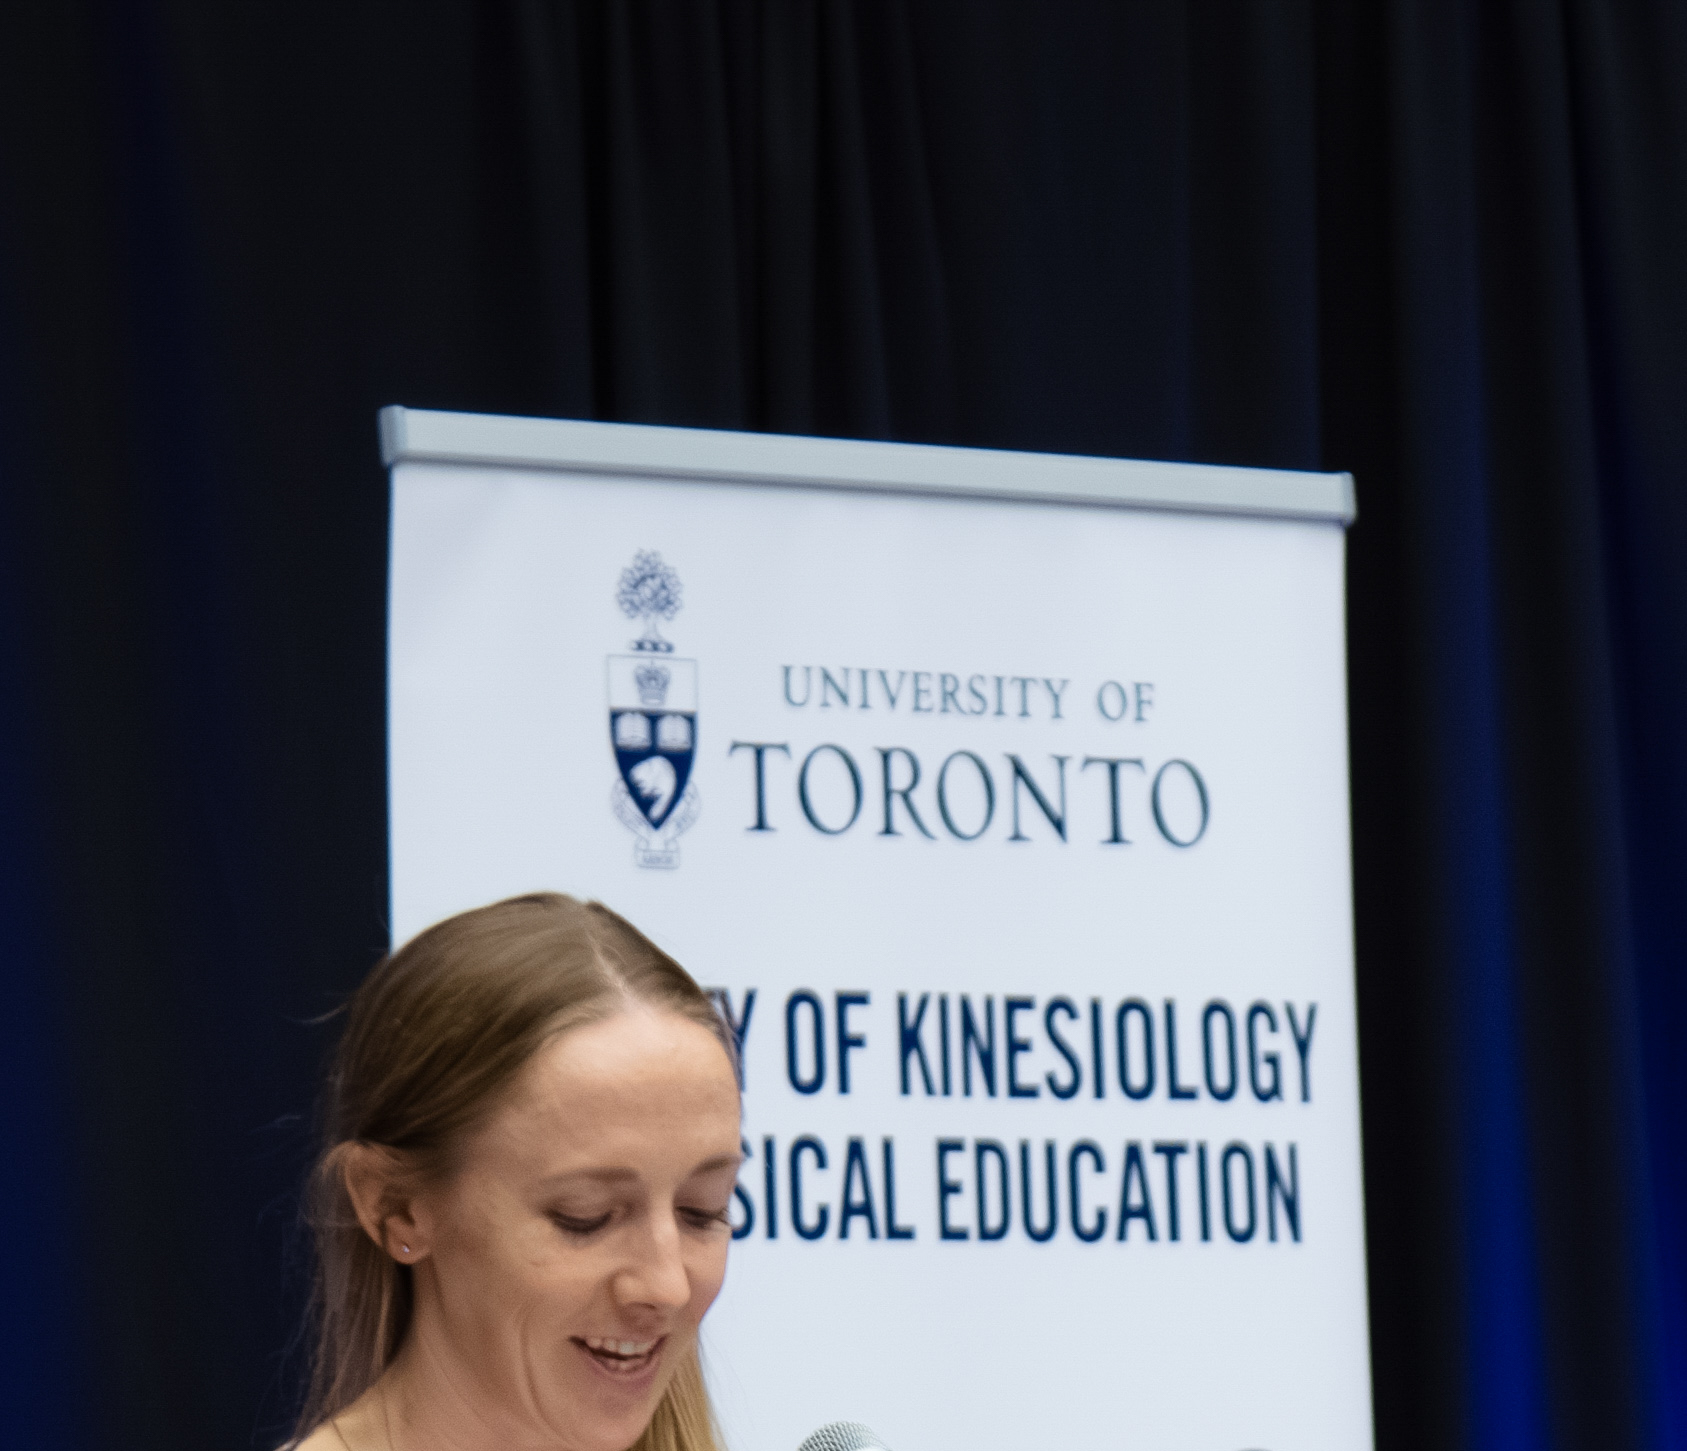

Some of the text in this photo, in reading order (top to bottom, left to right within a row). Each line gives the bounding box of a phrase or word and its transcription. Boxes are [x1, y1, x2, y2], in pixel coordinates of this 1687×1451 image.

[780, 664, 1156, 724] UNIVERSITY OF
[729, 740, 1211, 848] TORONTO
[784, 987, 871, 1096] OF
[896, 990, 1318, 1103] KINESIOLOGY
[730, 1133, 1303, 1245] SICAL EDUCATION
